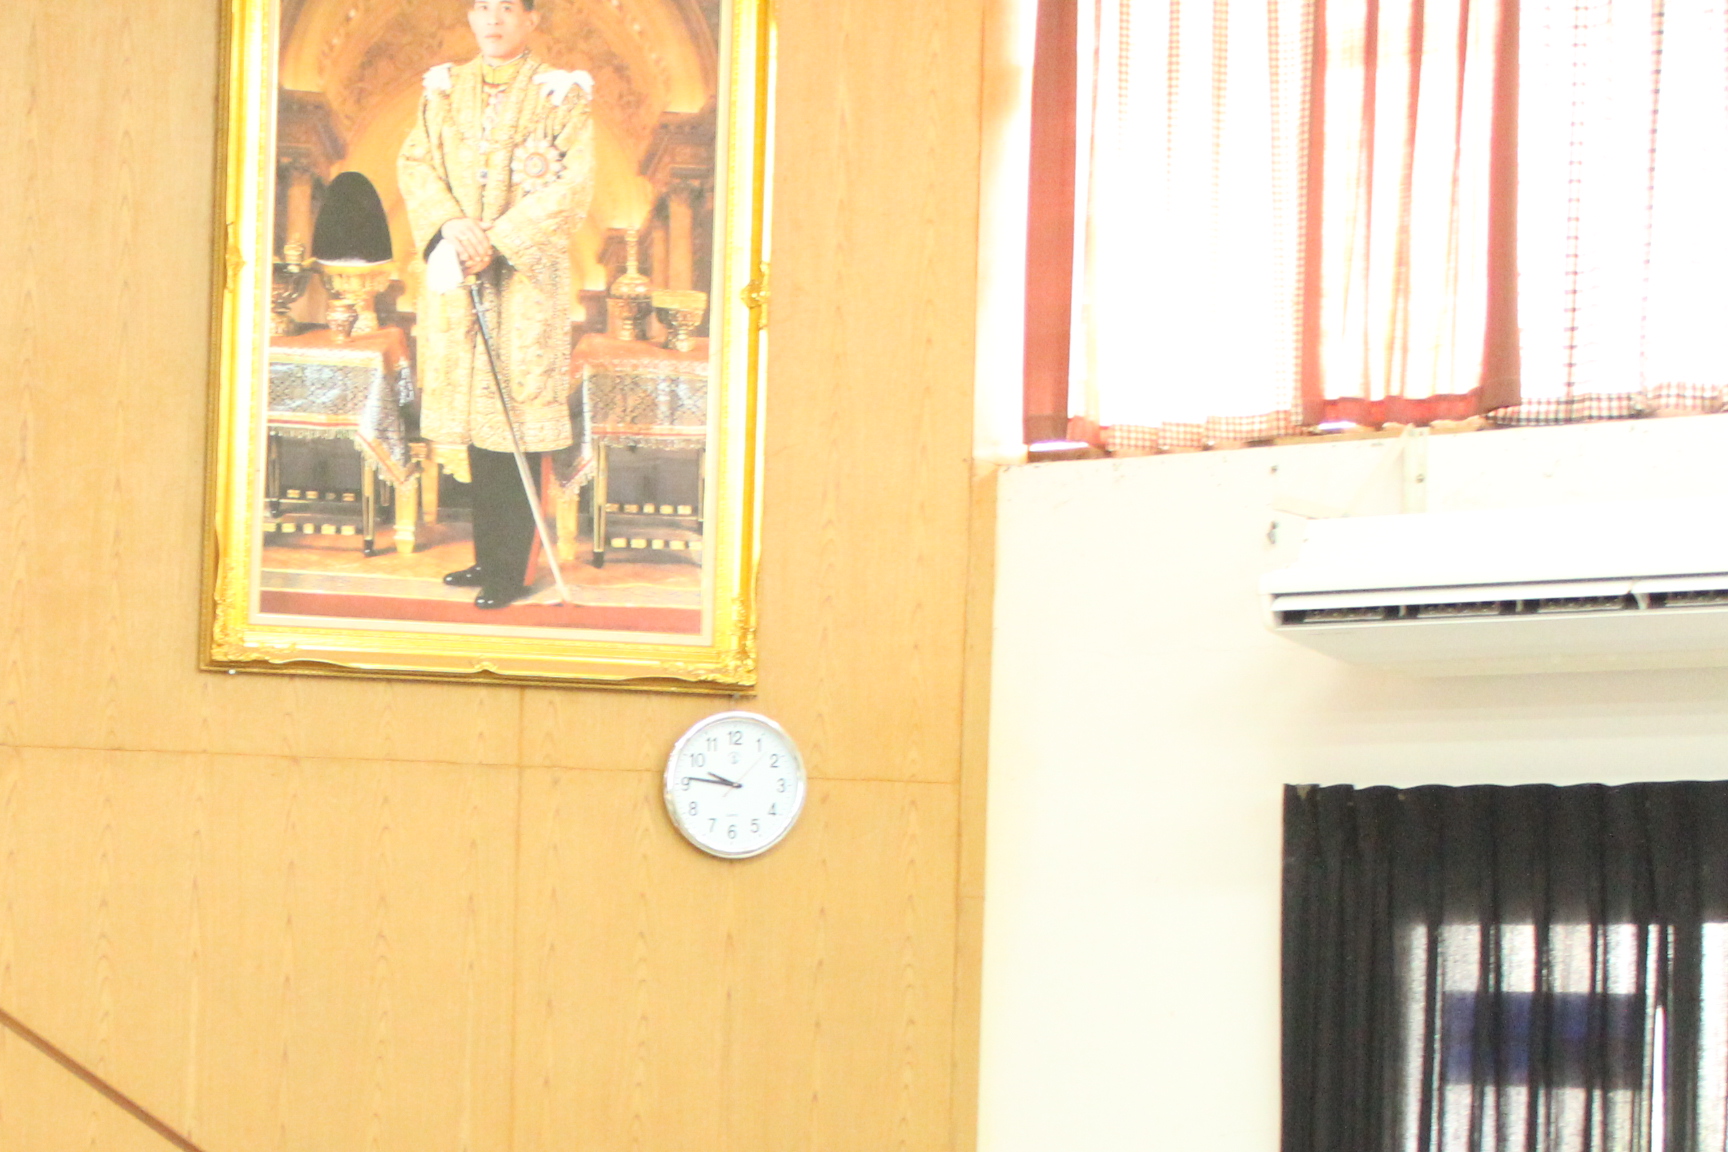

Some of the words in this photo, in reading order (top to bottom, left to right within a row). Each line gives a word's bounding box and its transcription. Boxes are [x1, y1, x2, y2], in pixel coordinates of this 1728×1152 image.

[706, 737, 717, 752] 11
[727, 730, 743, 746] 12
[756, 738, 762, 752] 1
[690, 752, 705, 768] 10
[770, 753, 779, 768] 2
[681, 776, 691, 792] 9
[777, 778, 786, 793] 3
[688, 801, 697, 816] 8
[768, 803, 777, 816] 4
[708, 818, 717, 832] 7
[727, 824, 737, 839] 6
[751, 818, 760, 833] 5
